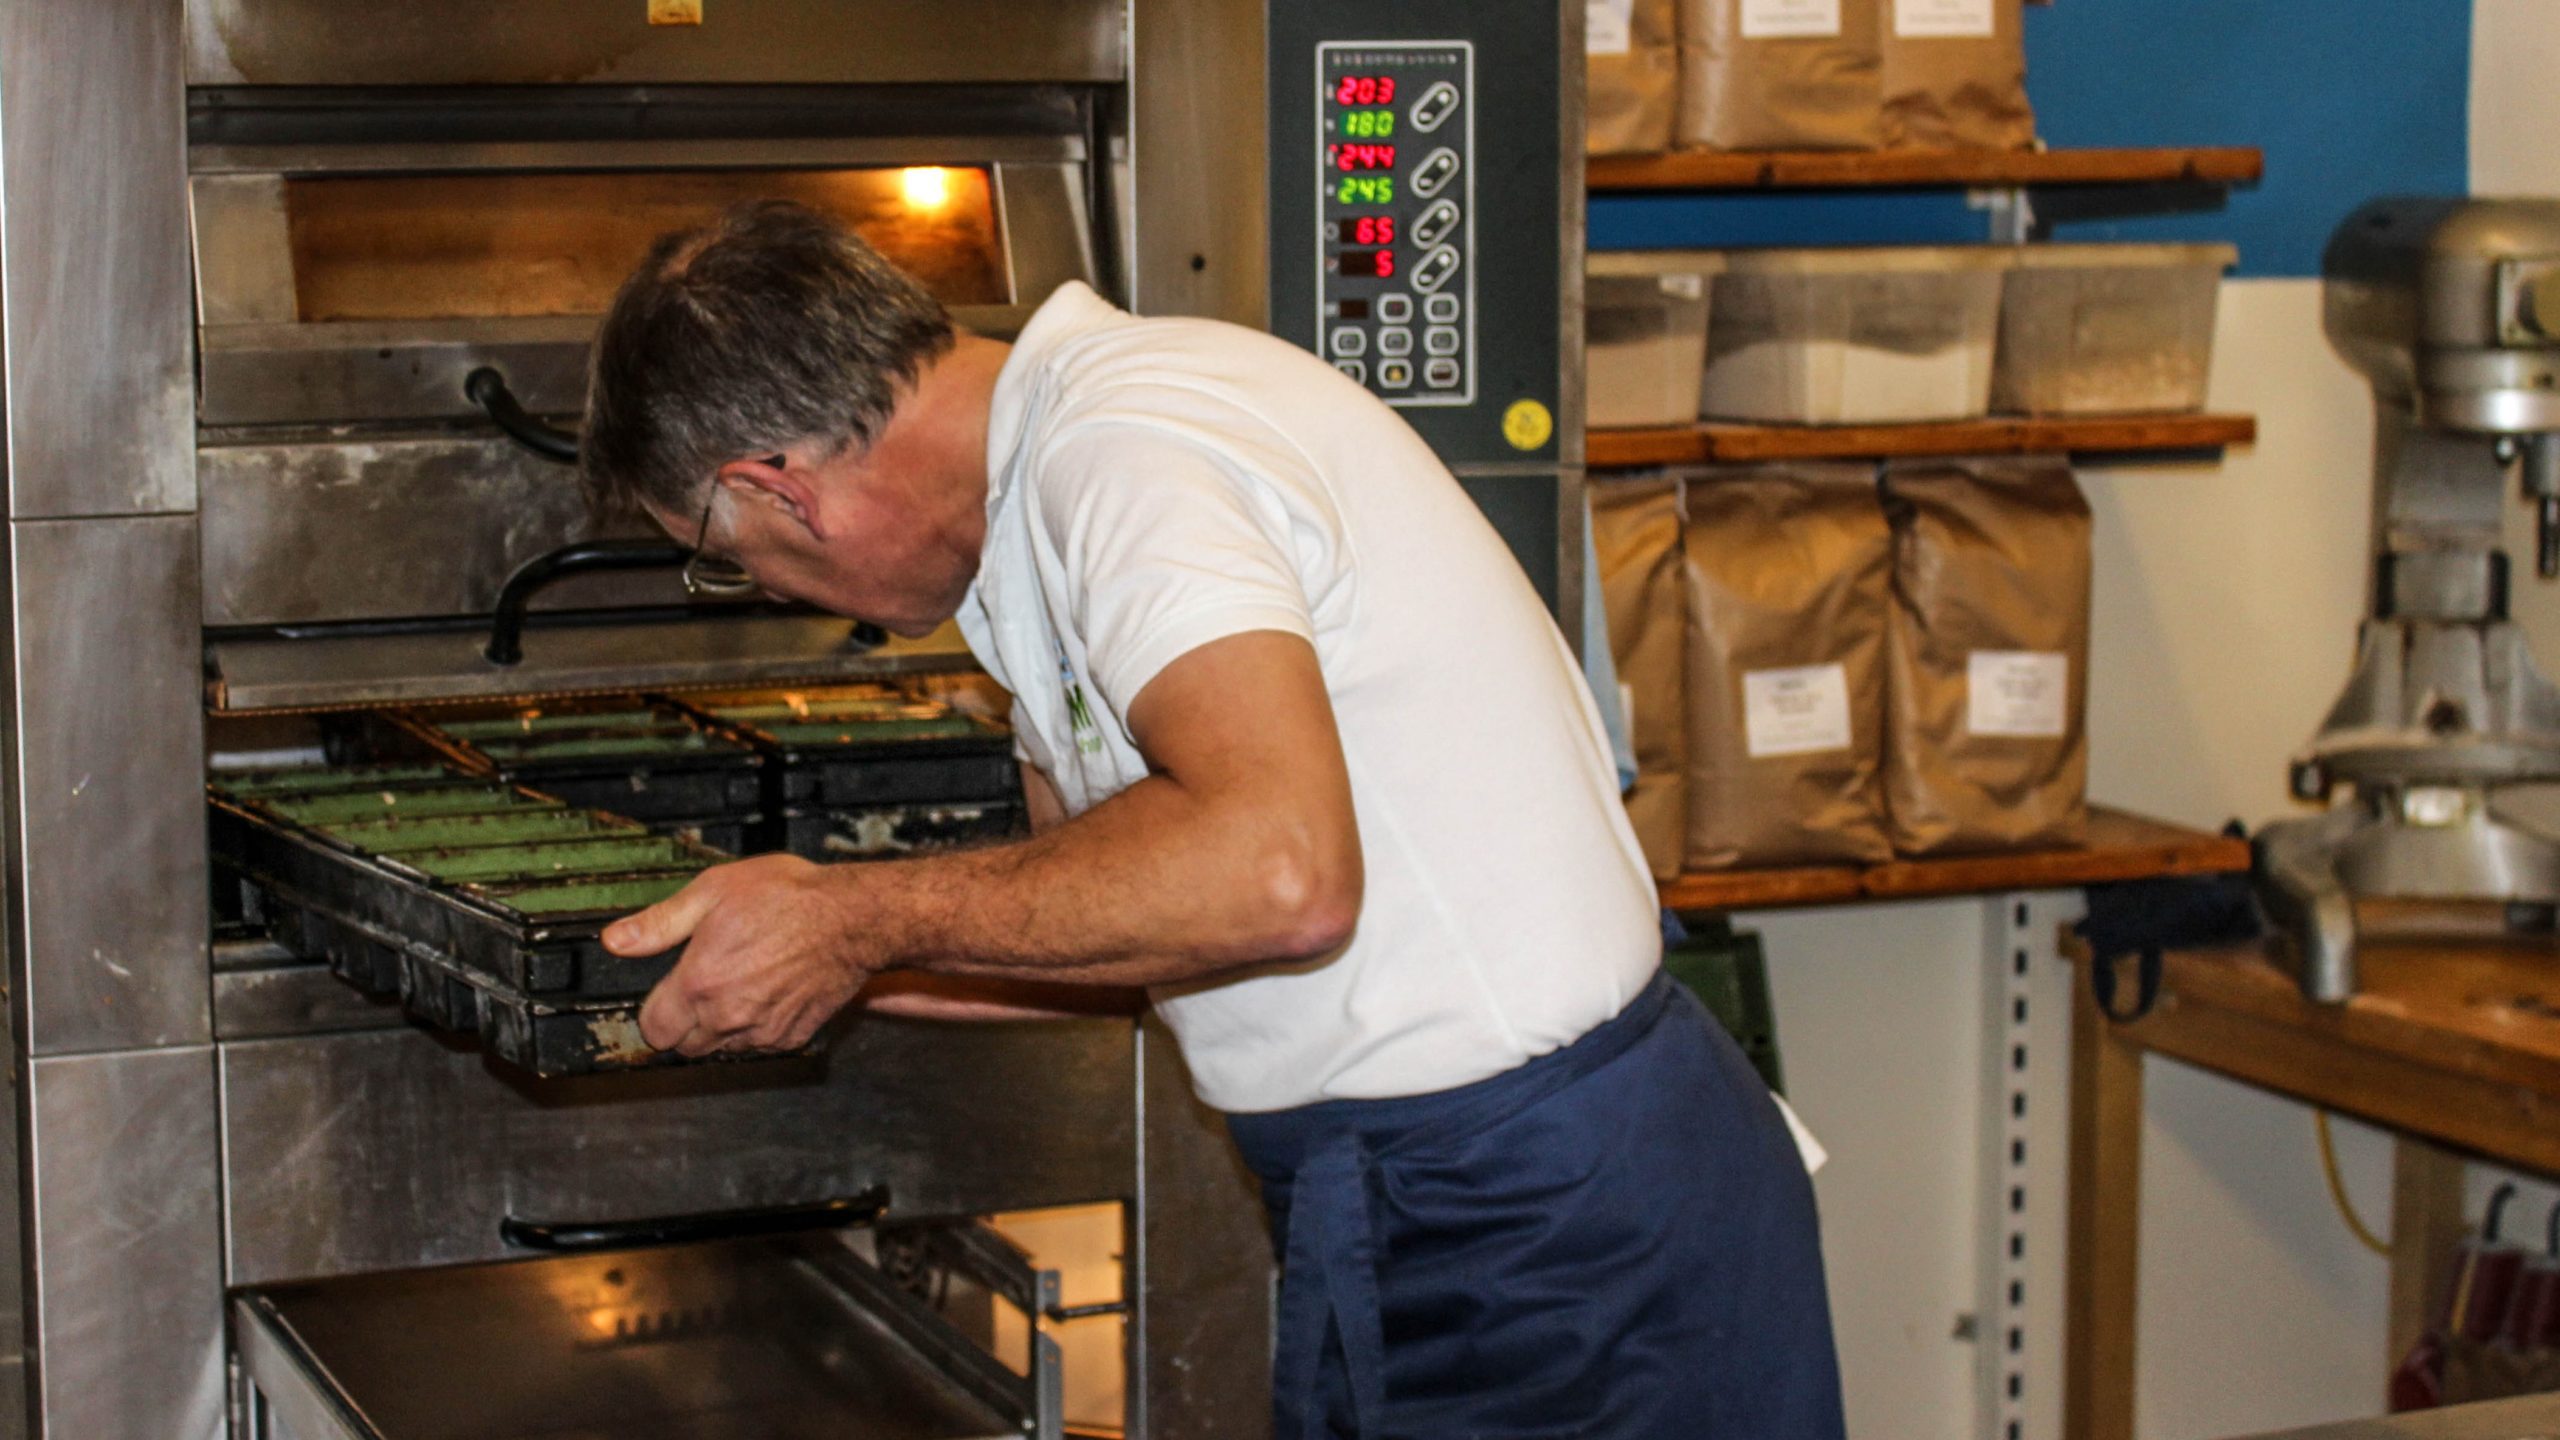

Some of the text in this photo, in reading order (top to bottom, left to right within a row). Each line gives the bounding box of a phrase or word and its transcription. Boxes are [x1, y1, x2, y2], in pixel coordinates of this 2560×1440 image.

[1336, 76, 1396, 106] 203
[1346, 111, 1394, 137] 180
[1337, 143, 1396, 172] 244
[1337, 177, 1393, 205] 245
[1356, 215, 1395, 245] 65
[1375, 249, 1395, 278] 5
